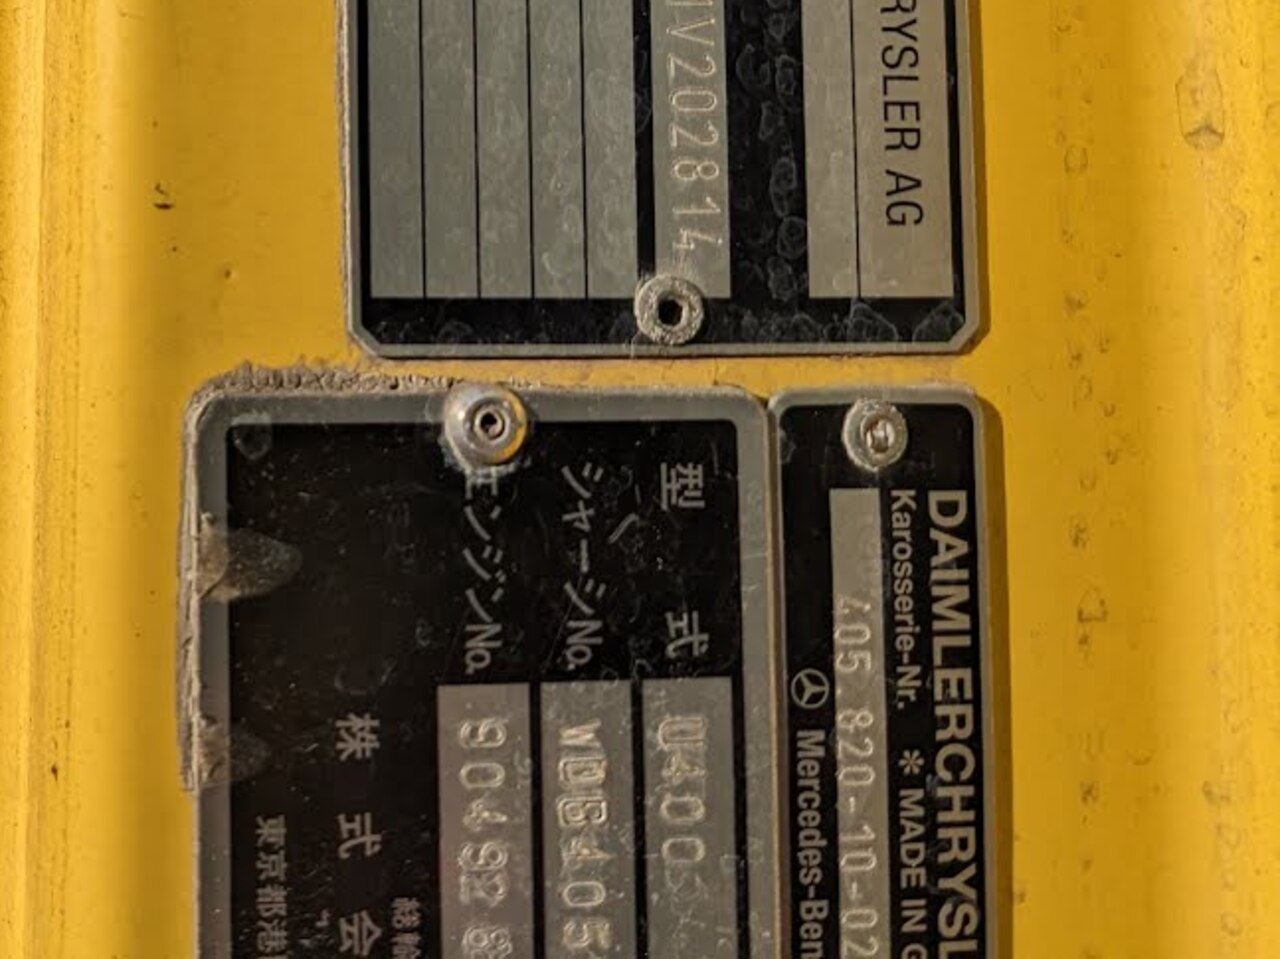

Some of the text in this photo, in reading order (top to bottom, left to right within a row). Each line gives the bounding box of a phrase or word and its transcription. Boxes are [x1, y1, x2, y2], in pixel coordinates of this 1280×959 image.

[885, 168, 924, 228] AG
[889, 489, 923, 709] Karosserie-Nr.
[929, 489, 979, 959] DAIMLERCHRYSL
[254, 813, 288, 959] 東京都港
[795, 730, 830, 959] Mercedes-Ben
[898, 789, 928, 888] MADE
[900, 899, 929, 933] IN
